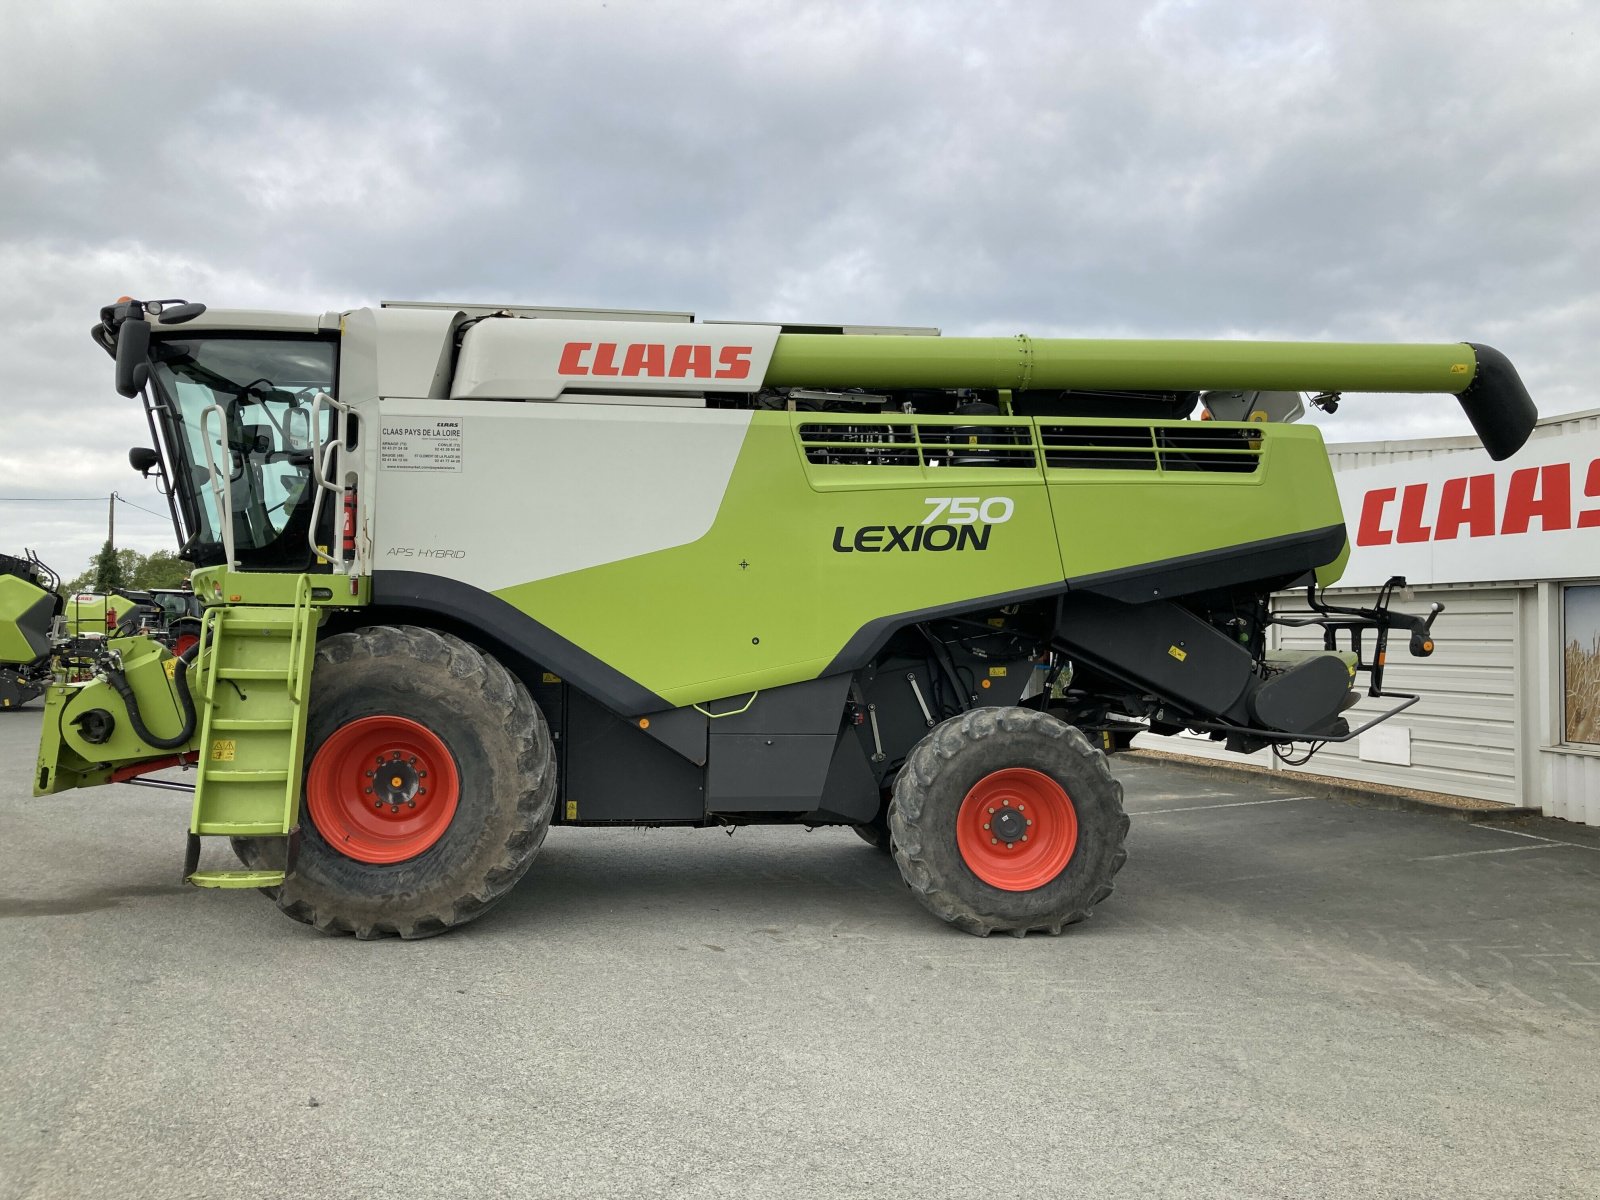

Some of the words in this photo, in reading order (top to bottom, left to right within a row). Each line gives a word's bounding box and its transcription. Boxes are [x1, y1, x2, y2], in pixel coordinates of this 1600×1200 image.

[558, 342, 752, 379] CLAAS
[383, 428, 403, 436] CLAAS
[921, 496, 1014, 525] 750
[387, 547, 414, 557] APS
[418, 548, 466, 559] HYBRID
[832, 524, 992, 553] LEXION
